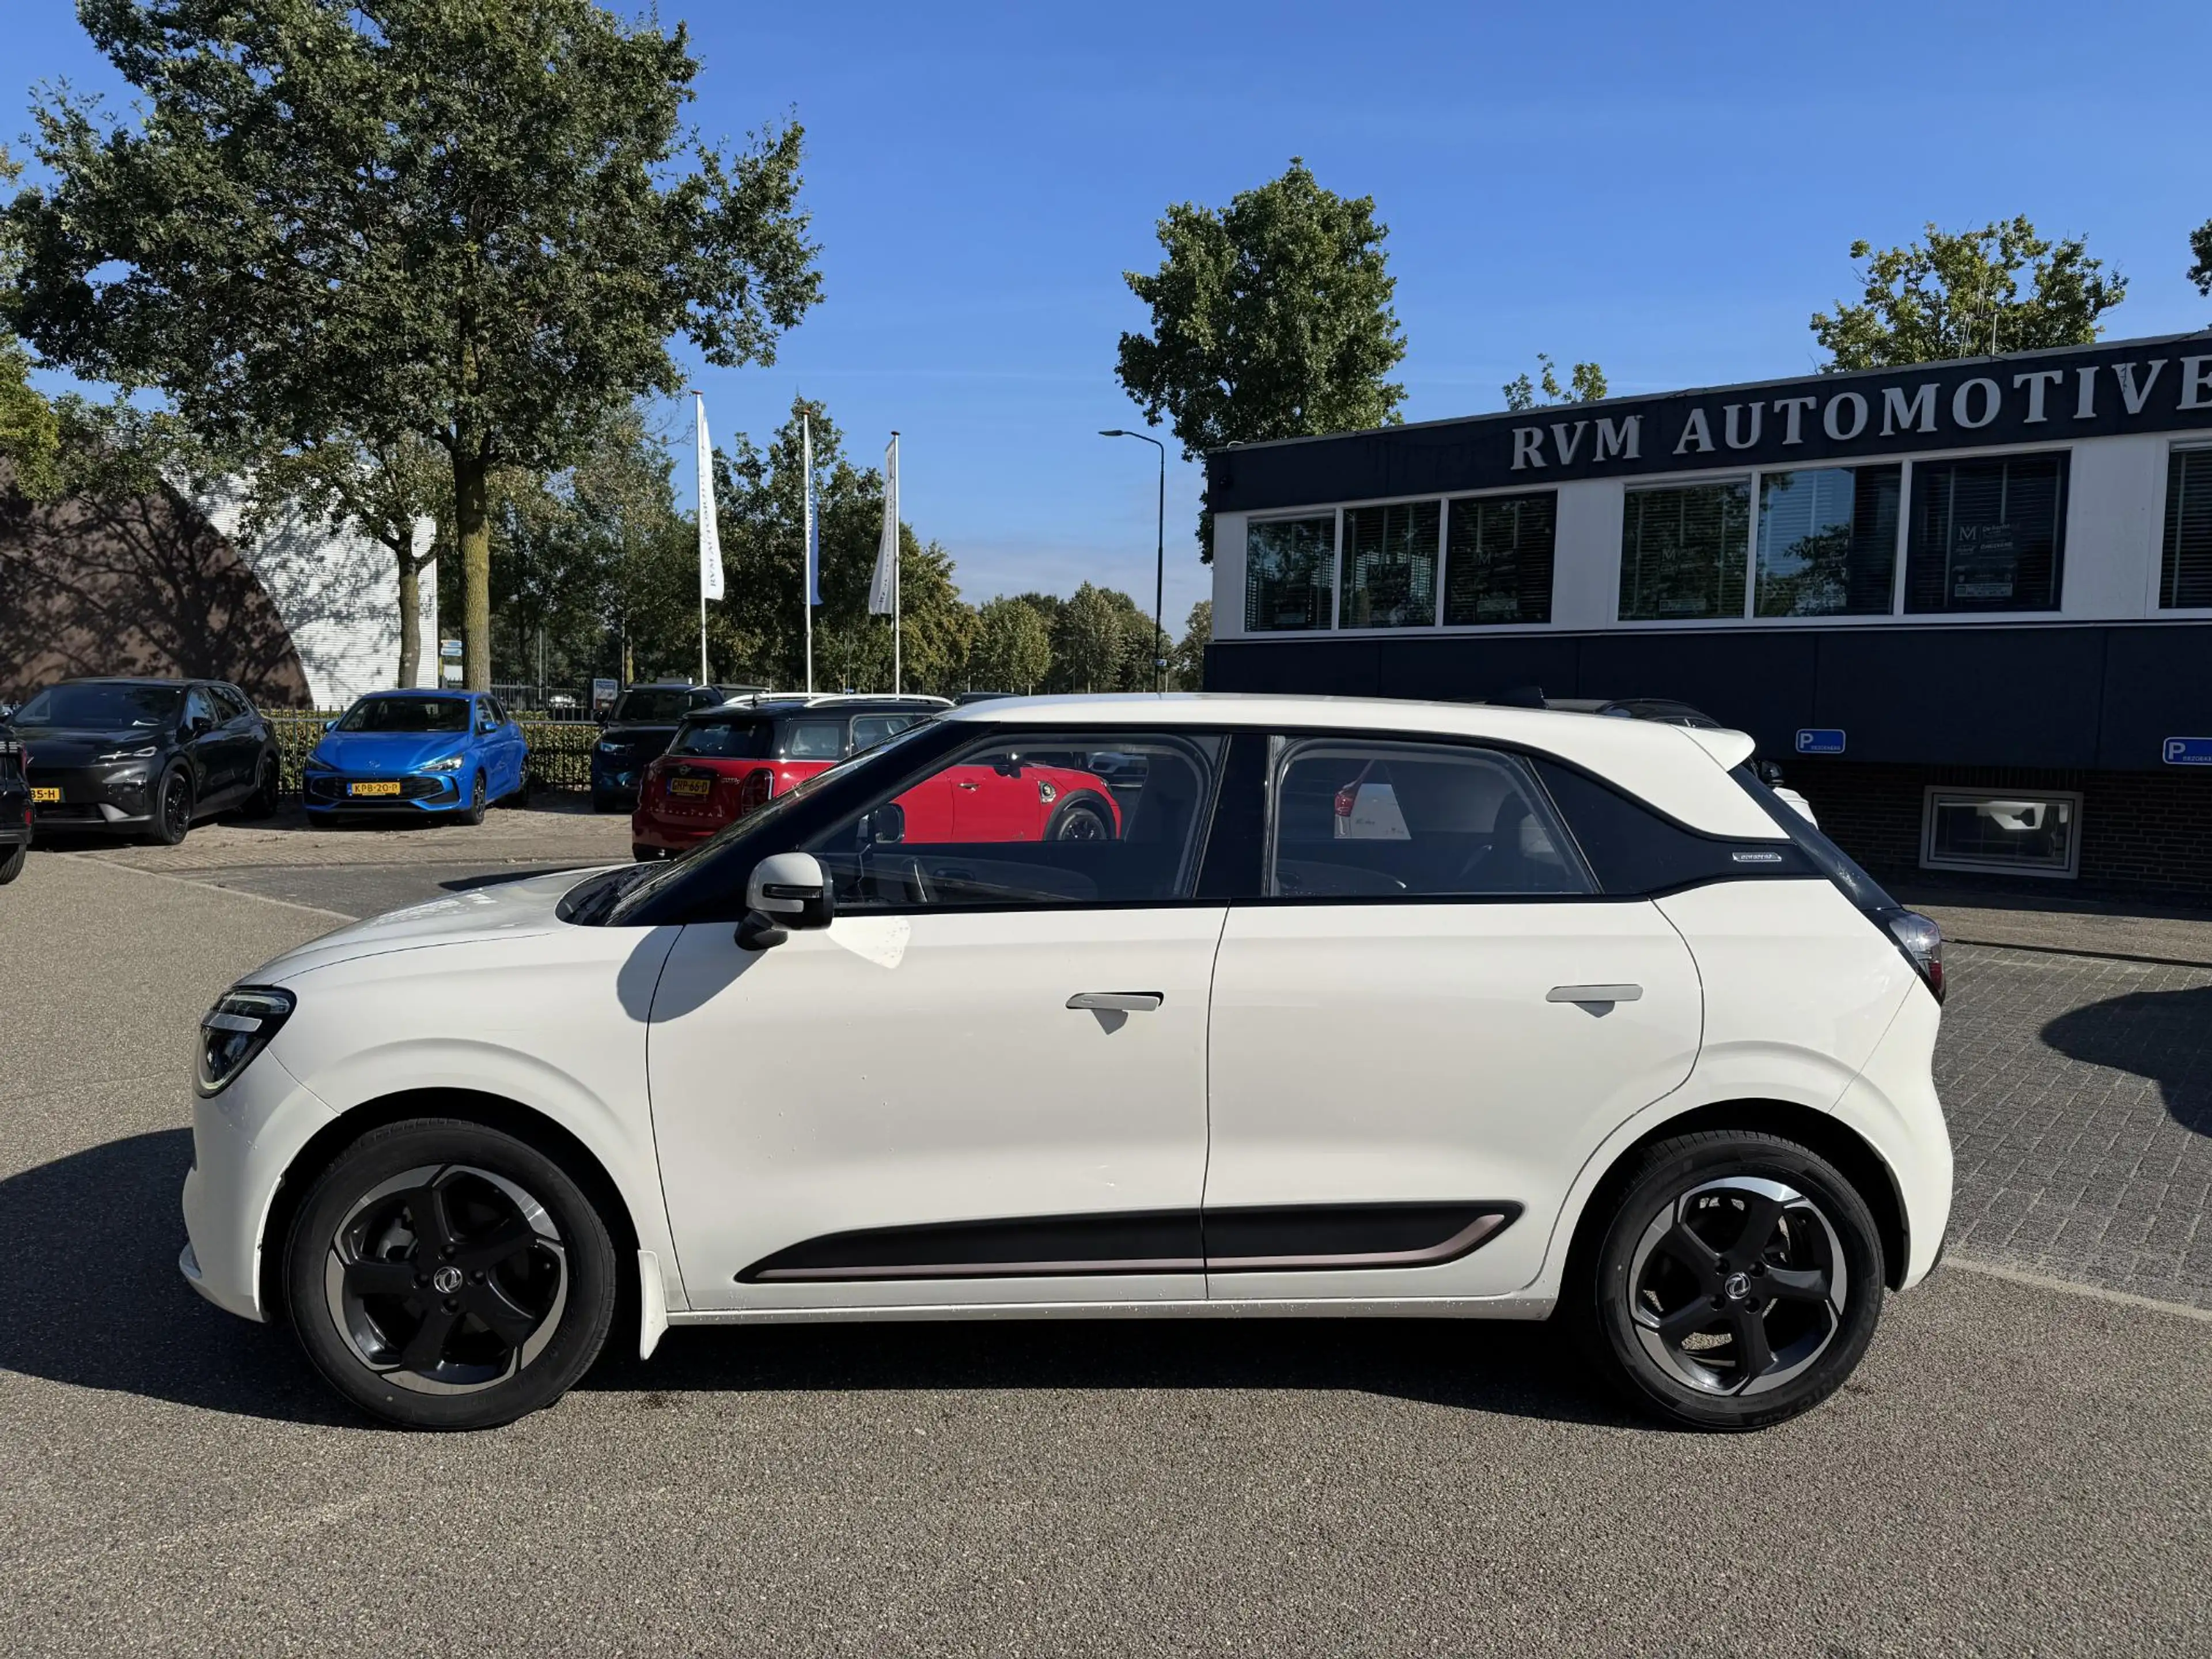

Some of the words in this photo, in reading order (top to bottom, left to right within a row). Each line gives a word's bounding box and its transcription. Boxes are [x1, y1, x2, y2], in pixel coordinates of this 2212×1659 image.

[1510, 415, 1645, 470] RVM
[1672, 354, 2212, 455] AUTOMOTIVE
[1800, 733, 1813, 748] P
[2168, 742, 2186, 759] P
[355, 783, 398, 793] KPB-20-R
